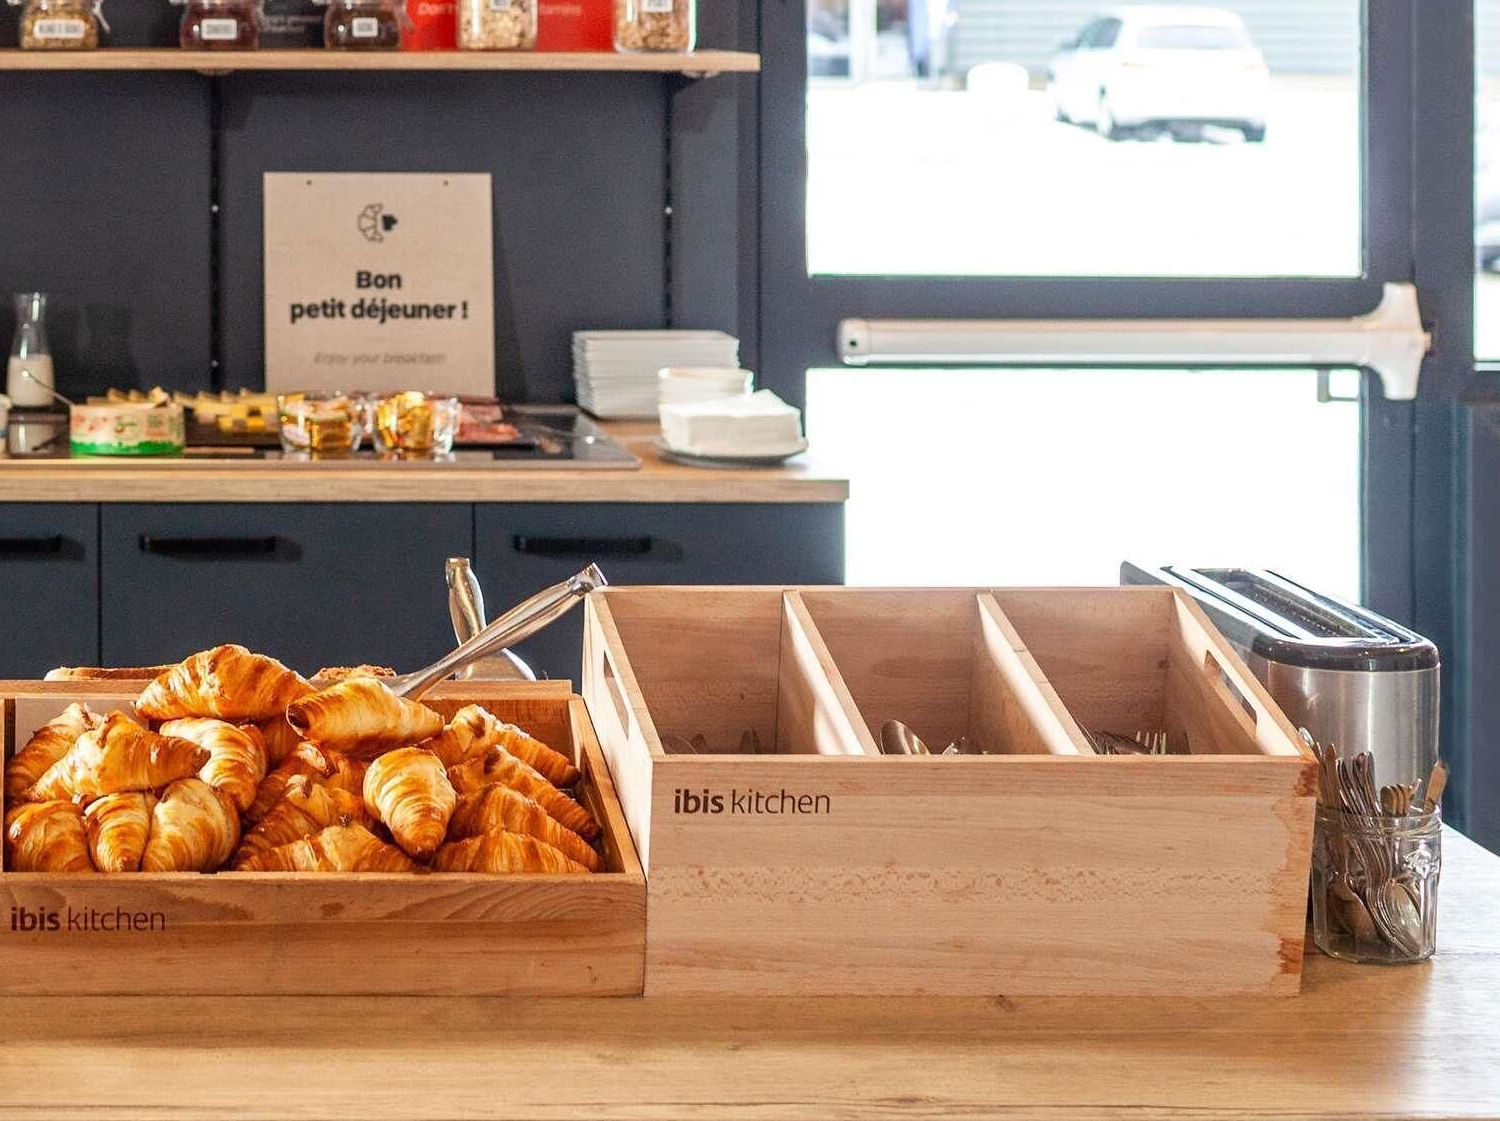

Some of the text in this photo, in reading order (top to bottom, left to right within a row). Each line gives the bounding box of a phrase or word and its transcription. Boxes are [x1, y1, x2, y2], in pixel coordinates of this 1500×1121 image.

[355, 270, 402, 290] Bon
[290, 297, 469, 324] petit déjeuner !
[674, 787, 831, 815] ibis kitchen
[10, 905, 167, 932] ibis kitchen
